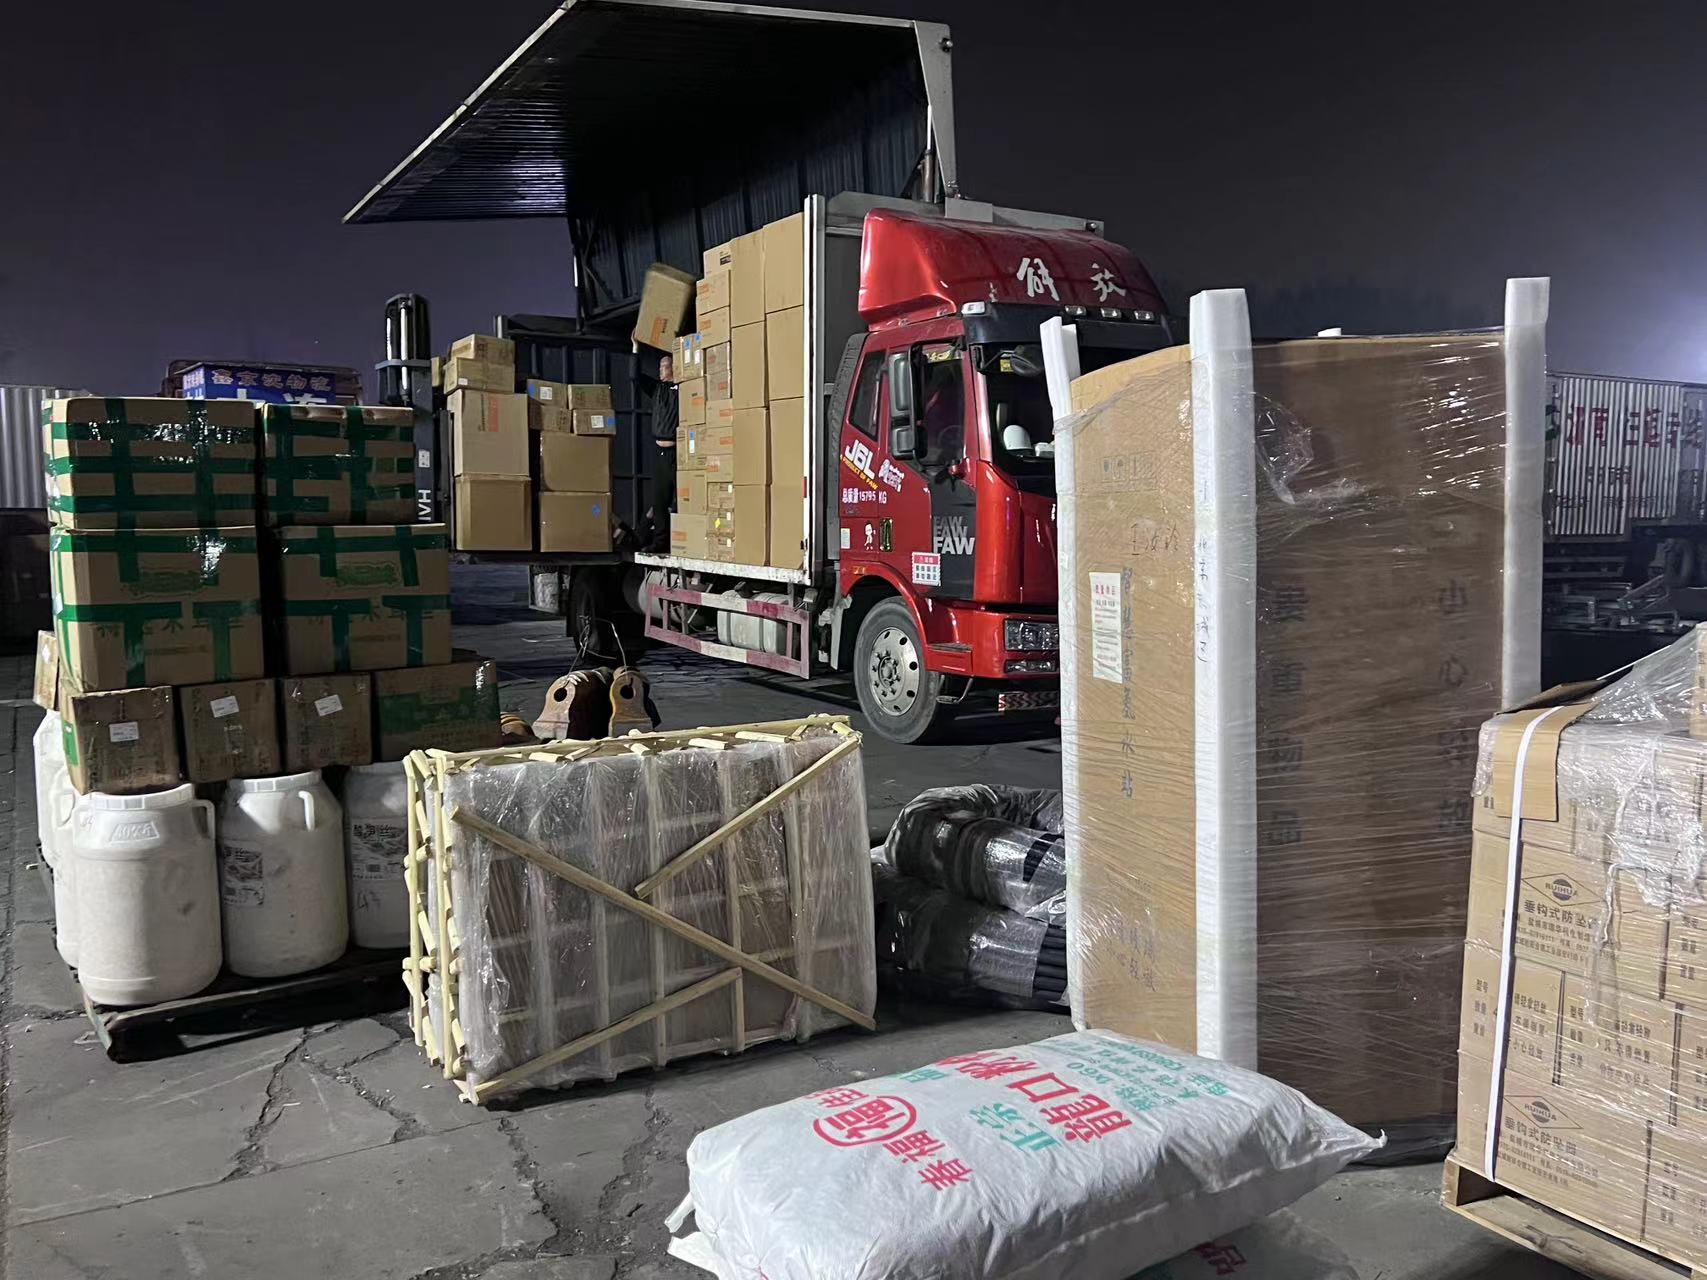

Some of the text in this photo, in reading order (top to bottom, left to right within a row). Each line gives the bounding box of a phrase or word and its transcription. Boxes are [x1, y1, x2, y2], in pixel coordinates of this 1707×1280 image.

[933, 526, 968, 538] FAW
[933, 536, 975, 555] FAW
[1524, 899, 1598, 930] 垂钩式防坠
